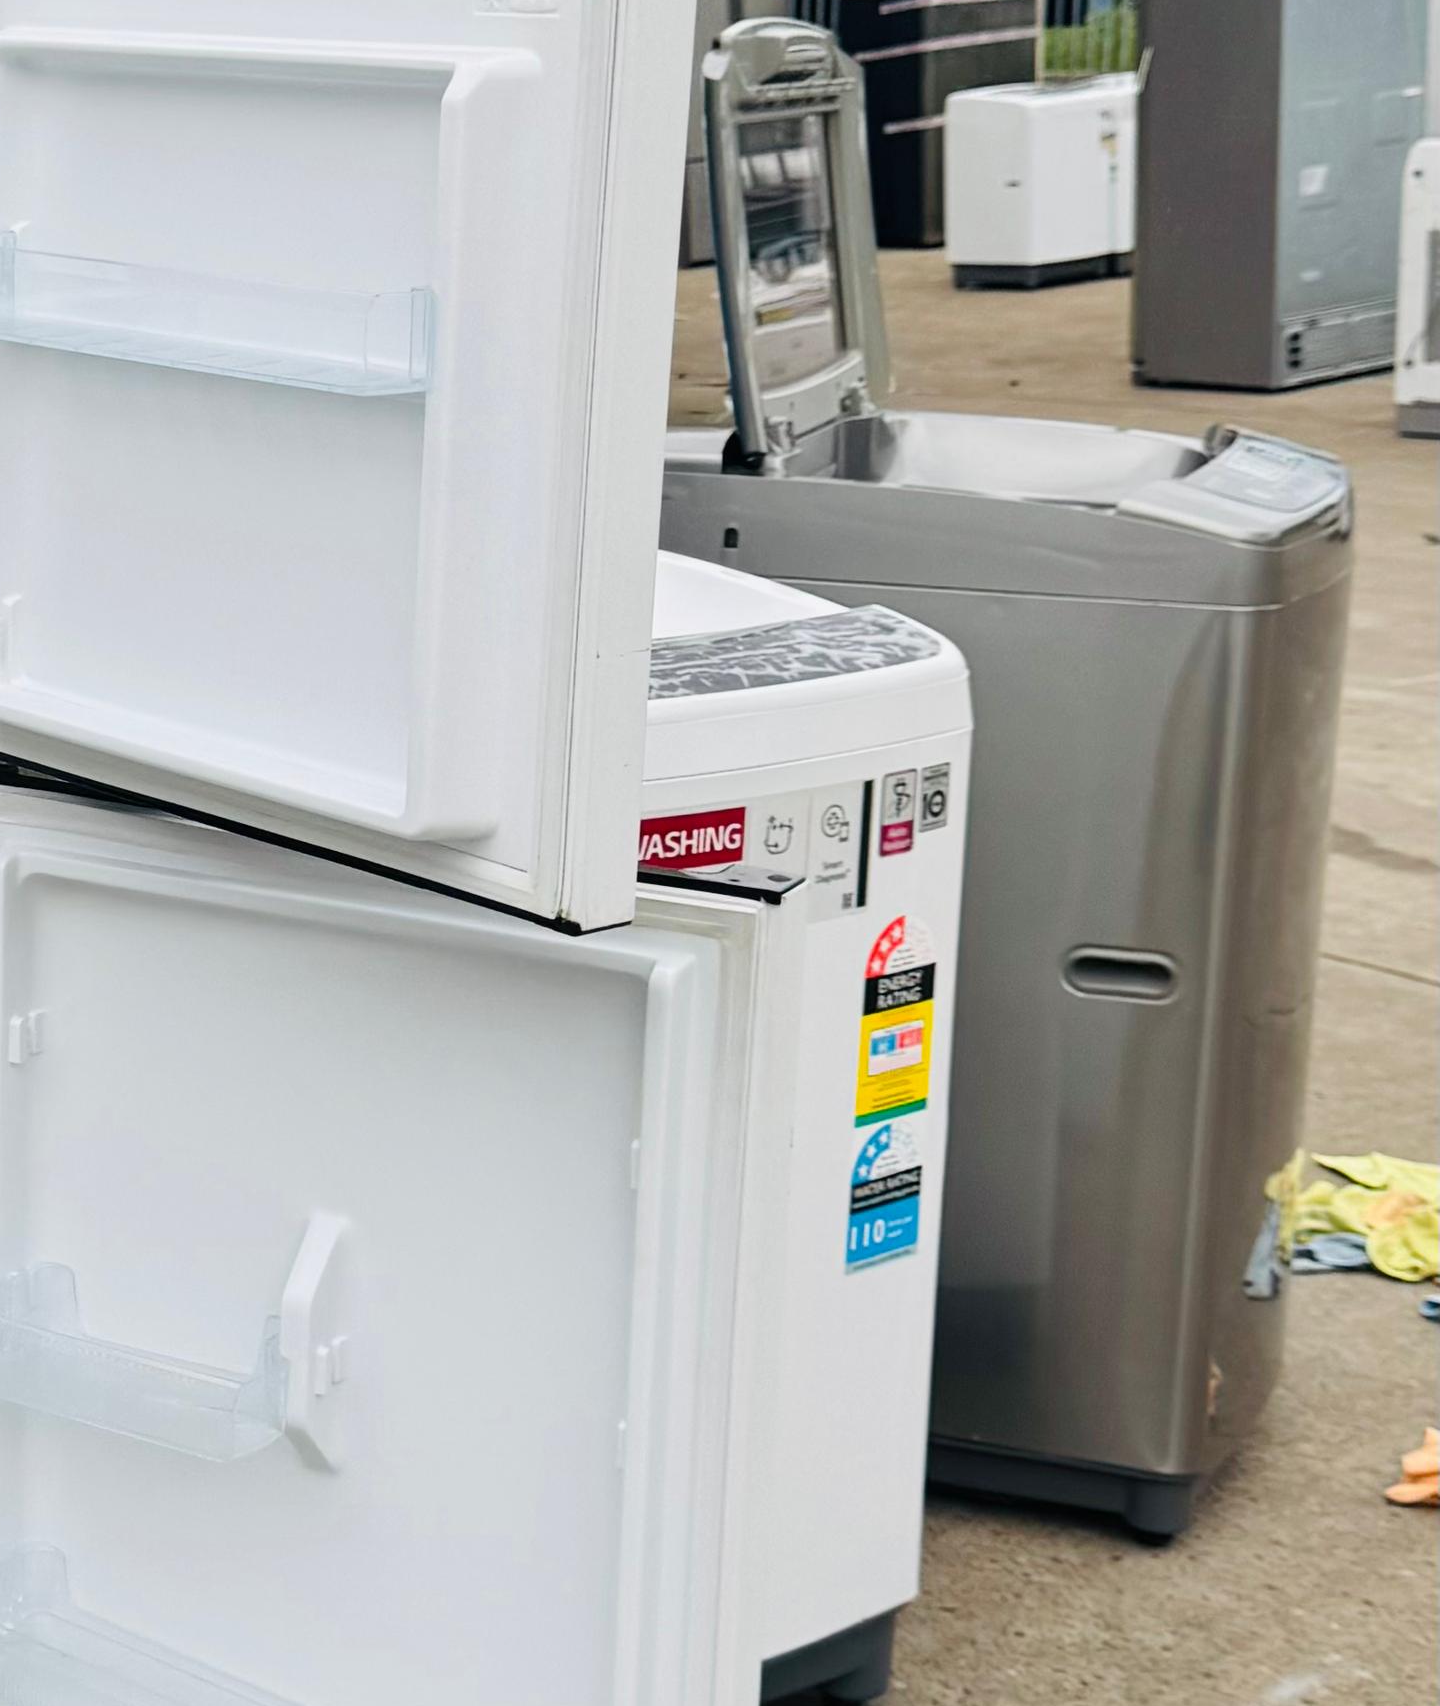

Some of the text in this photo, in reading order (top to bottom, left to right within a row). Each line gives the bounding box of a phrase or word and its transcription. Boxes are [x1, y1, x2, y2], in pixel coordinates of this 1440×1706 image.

[877, 970, 923, 993] ENERGY
[877, 986, 922, 1009] RATING
[850, 1219, 886, 1250] 110
